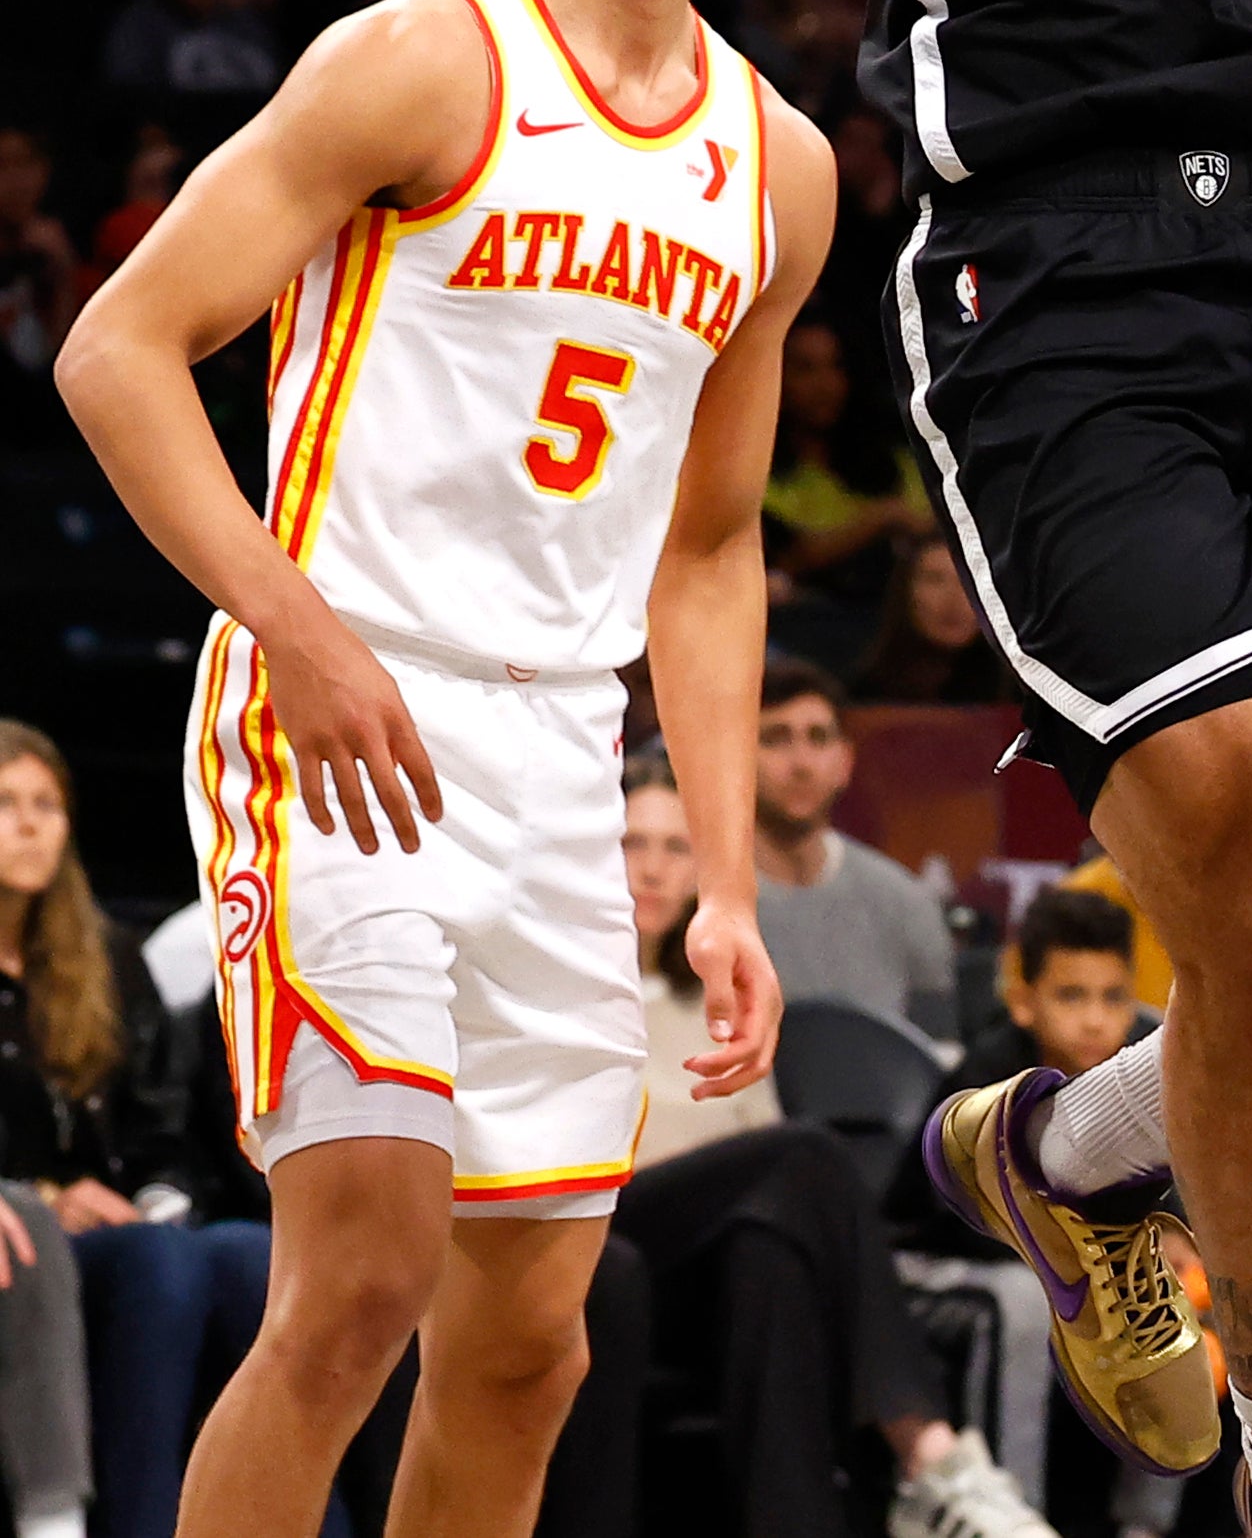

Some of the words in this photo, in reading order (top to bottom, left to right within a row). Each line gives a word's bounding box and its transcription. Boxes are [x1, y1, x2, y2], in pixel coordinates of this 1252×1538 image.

[1185, 155, 1226, 176] NETS
[445, 210, 741, 357] ATLANTA
[521, 338, 637, 502] 5
